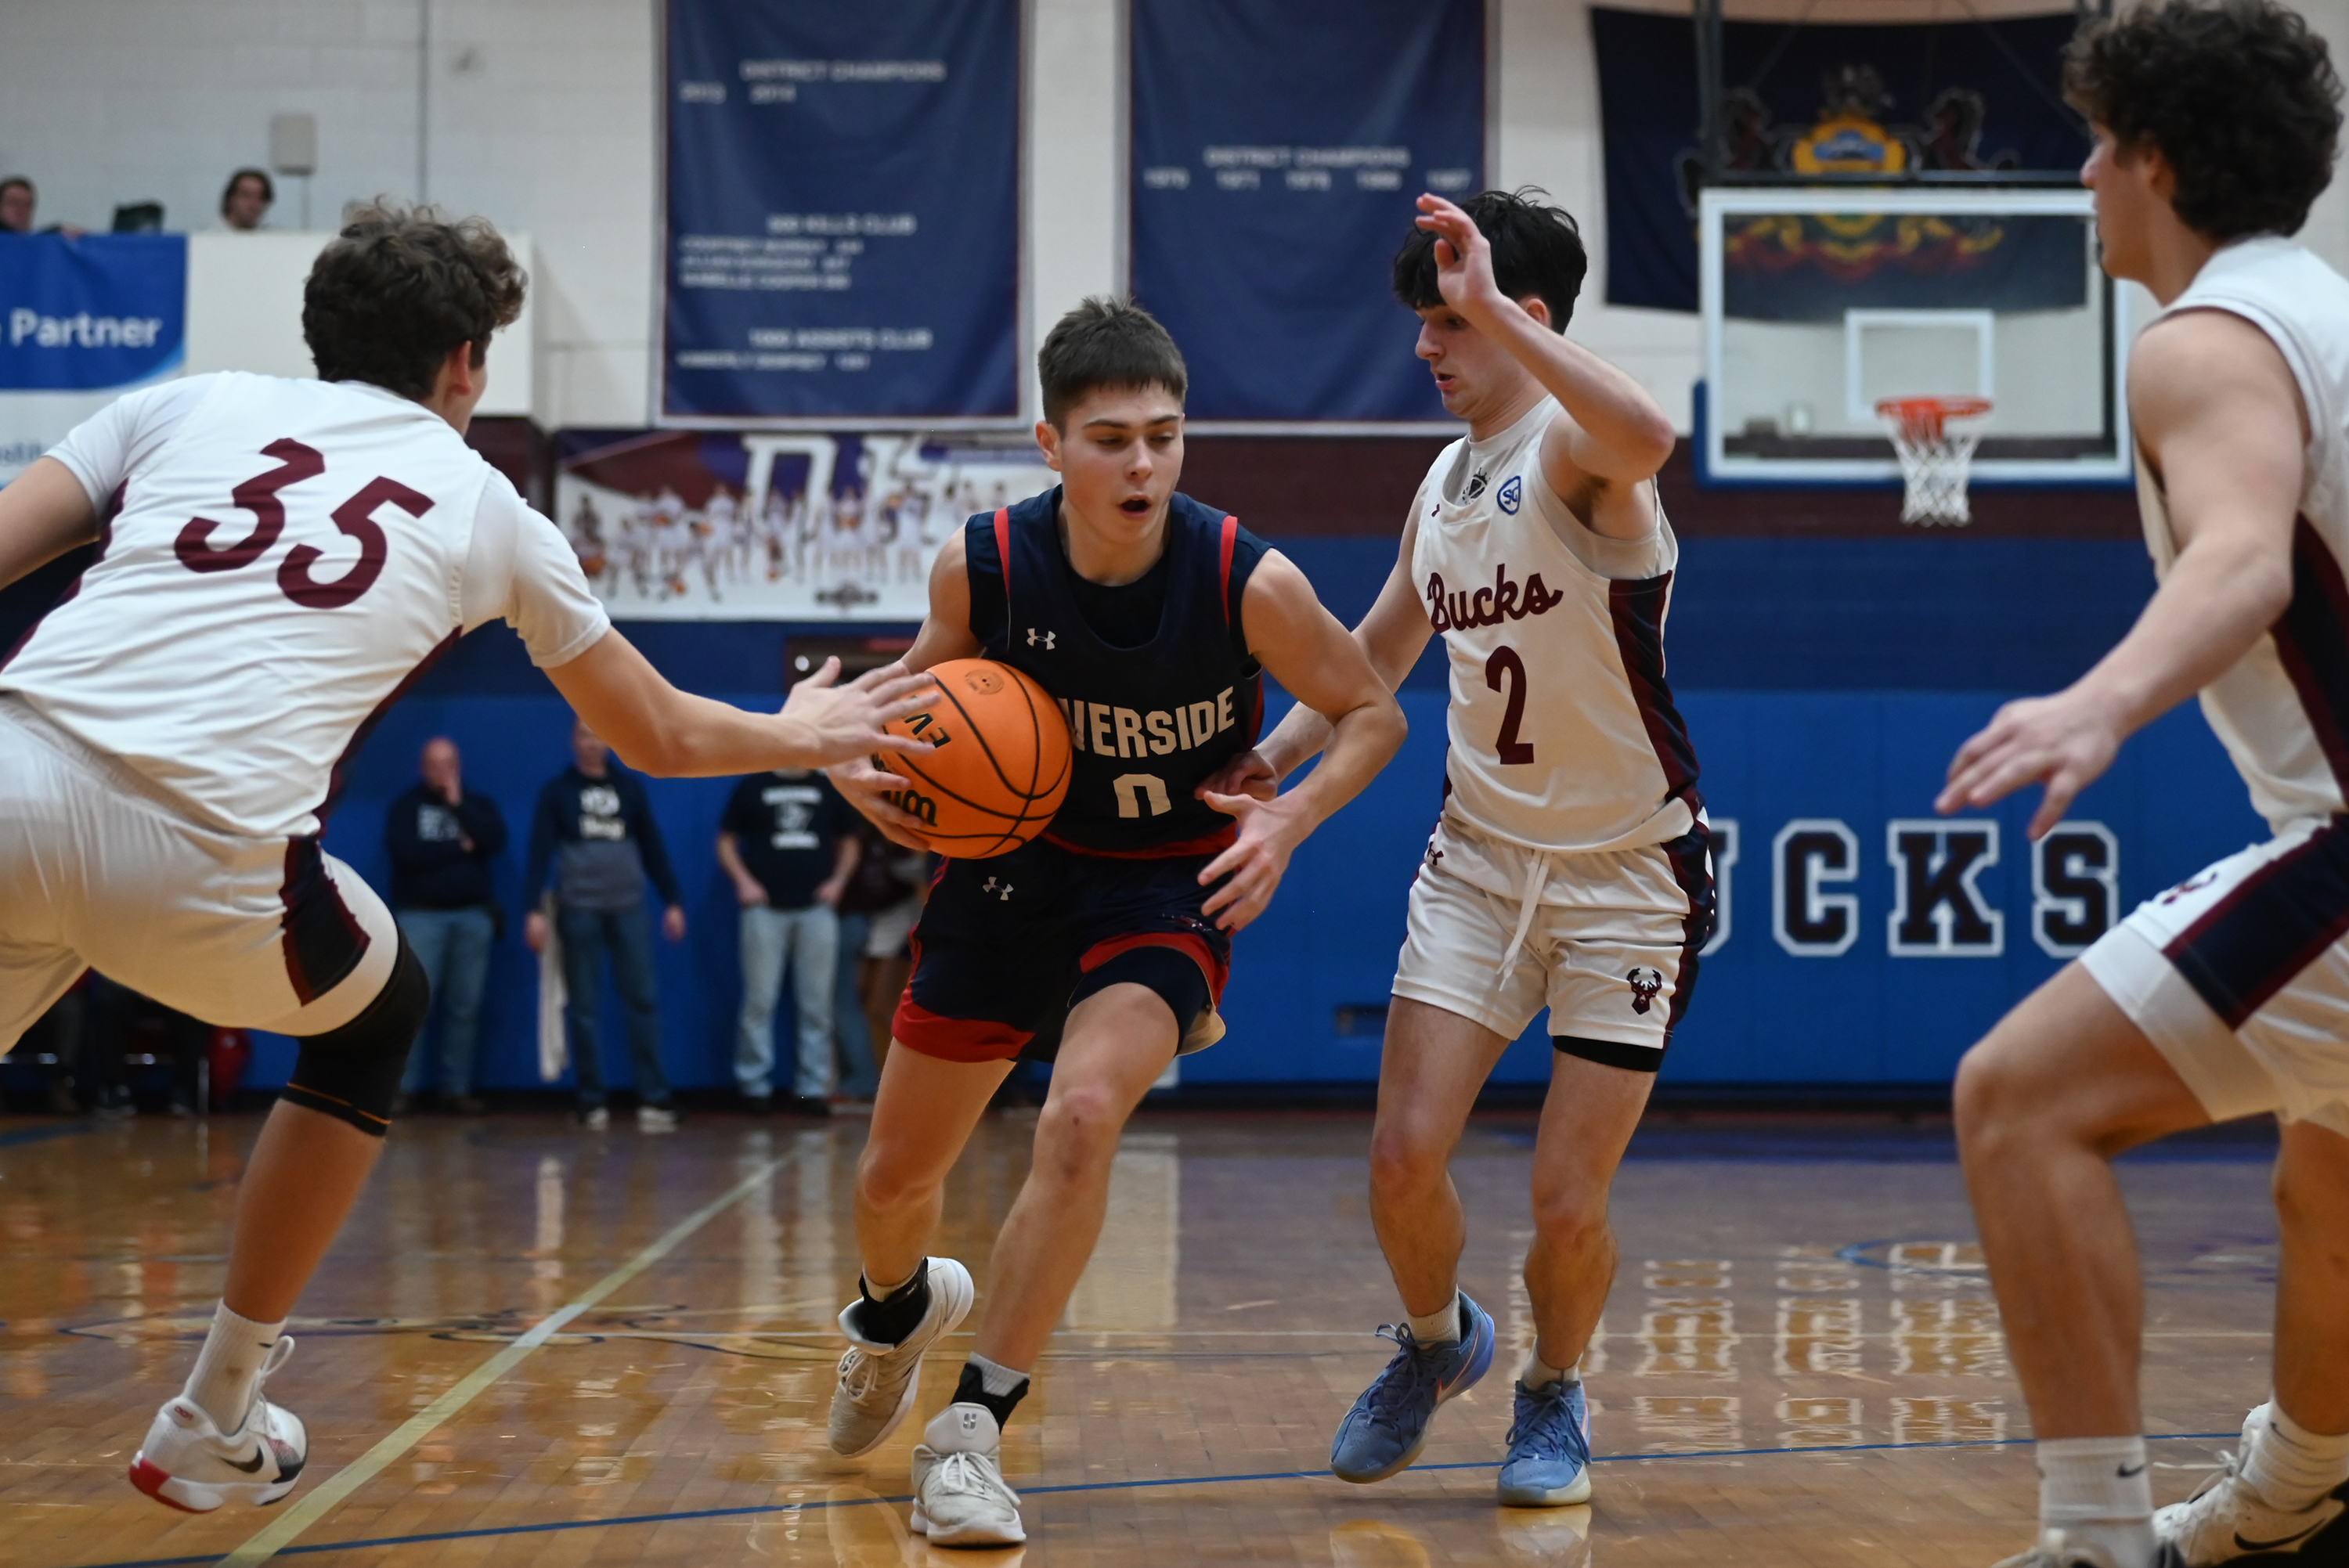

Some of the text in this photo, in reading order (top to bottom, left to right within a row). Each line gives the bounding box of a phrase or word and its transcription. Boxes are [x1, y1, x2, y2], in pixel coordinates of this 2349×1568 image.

[9, 308, 163, 348] Partner
[175, 438, 435, 608] 35
[1427, 564, 1564, 633] Bucks
[1485, 645, 1534, 765] 2
